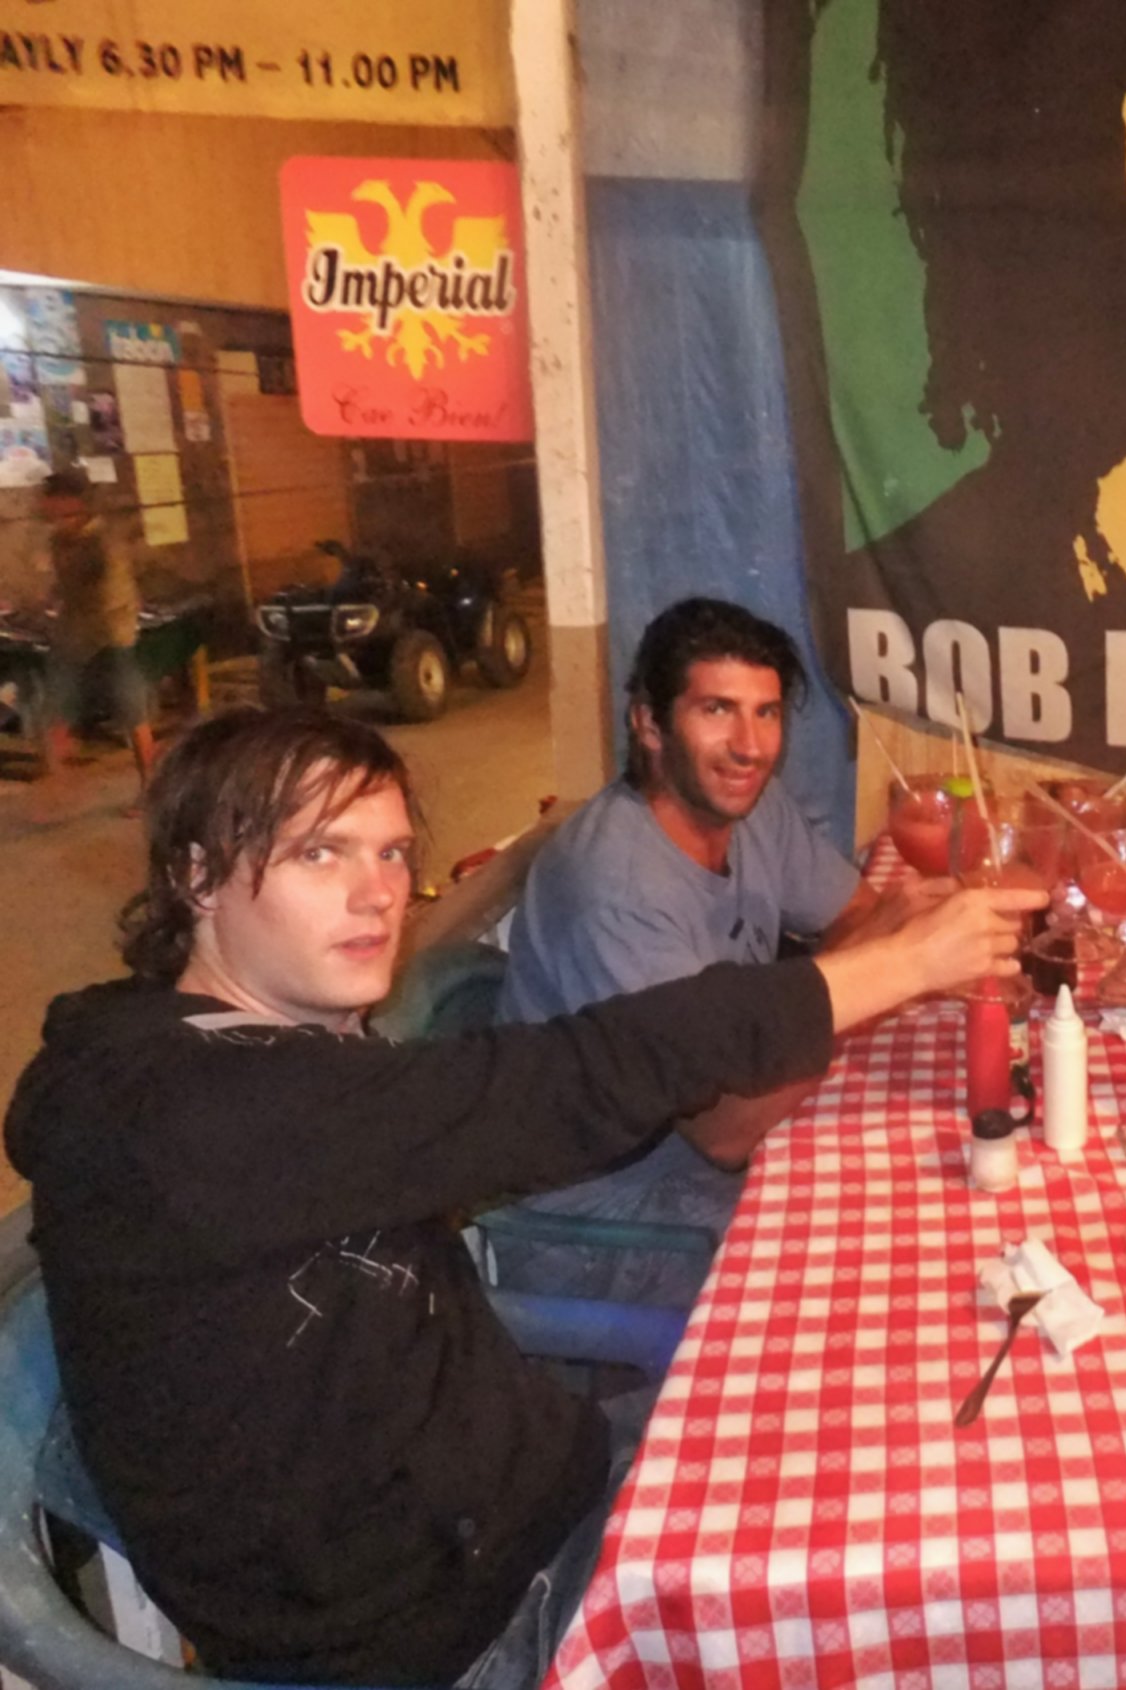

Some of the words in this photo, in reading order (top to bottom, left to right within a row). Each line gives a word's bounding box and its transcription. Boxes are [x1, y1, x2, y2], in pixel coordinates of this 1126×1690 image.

[99, 38, 181, 80] 6.30
[192, 42, 247, 83] PM
[298, 49, 397, 90] 11.00
[409, 53, 460, 93] PM
[307, 247, 511, 332] Imperial
[847, 608, 1072, 742] BOB
